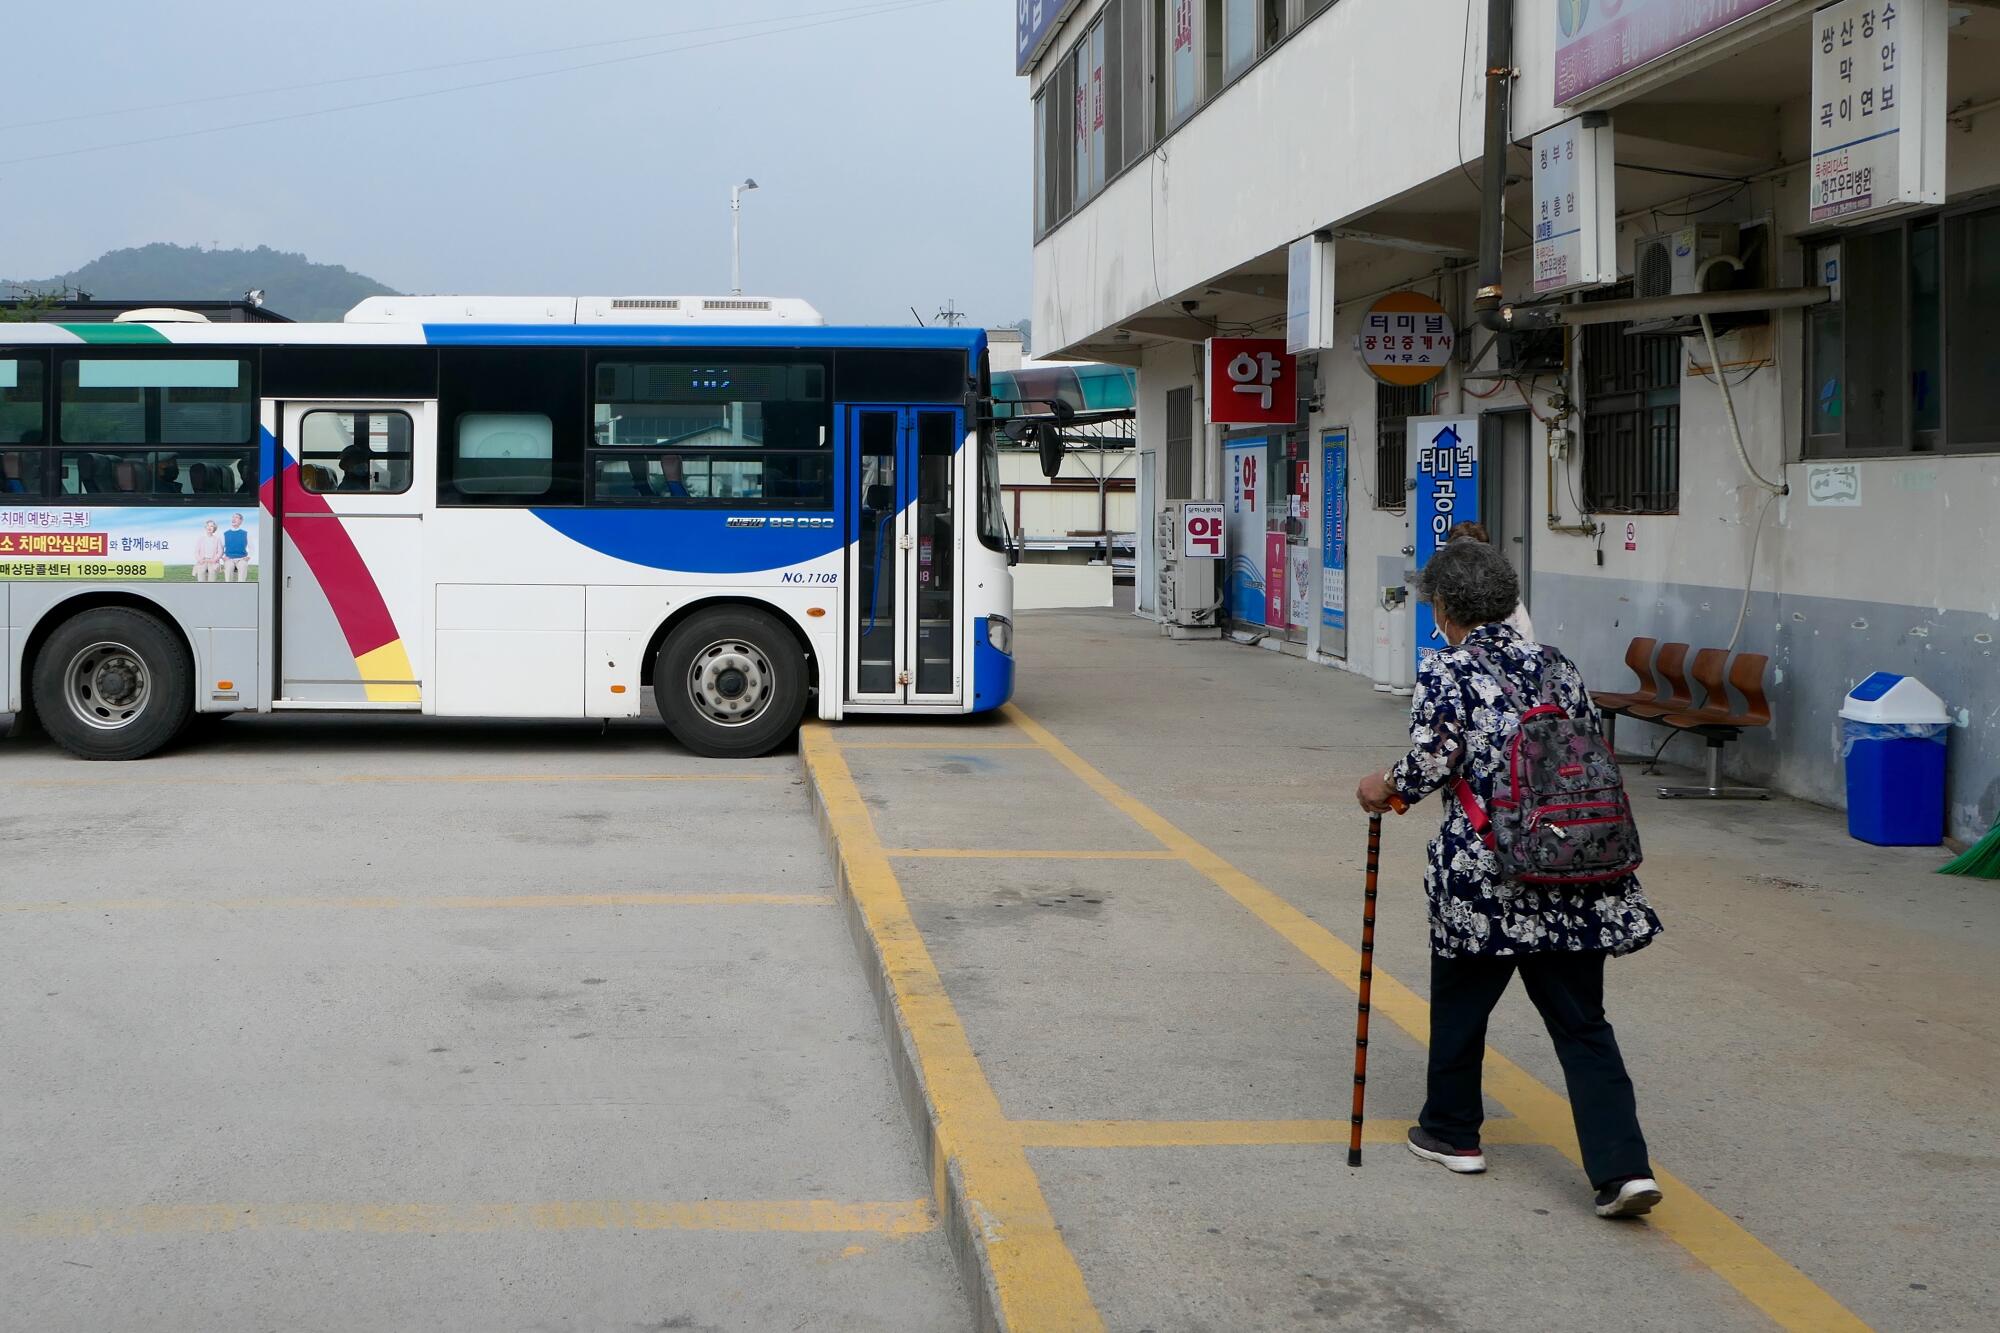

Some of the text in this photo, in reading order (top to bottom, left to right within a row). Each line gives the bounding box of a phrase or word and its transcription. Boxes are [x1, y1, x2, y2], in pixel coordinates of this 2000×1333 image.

[1840, 18, 1853, 122] 산막이
[1861, 9, 1876, 117] 장연
[1880, 2, 1896, 111] 수안보
[1820, 26, 1835, 128] 쌍곡
[1370, 315, 1443, 334] 터미널
[1364, 335, 1452, 351] 공인중개사
[1384, 354, 1431, 363] 사무소
[1227, 351, 1281, 410] 약
[1420, 447, 1473, 478] 터미널
[1243, 455, 1257, 513] 약
[1, 511, 90, 527] 치매 예방과 극복!
[19, 535, 103, 553] 치매안심센터
[109, 541, 119, 551] 와
[121, 537, 169, 552] 함께하세요
[1187, 517, 1223, 555] 약
[77, 564, 147, 576] 1899-9988
[781, 572, 838, 584] NO.1108
